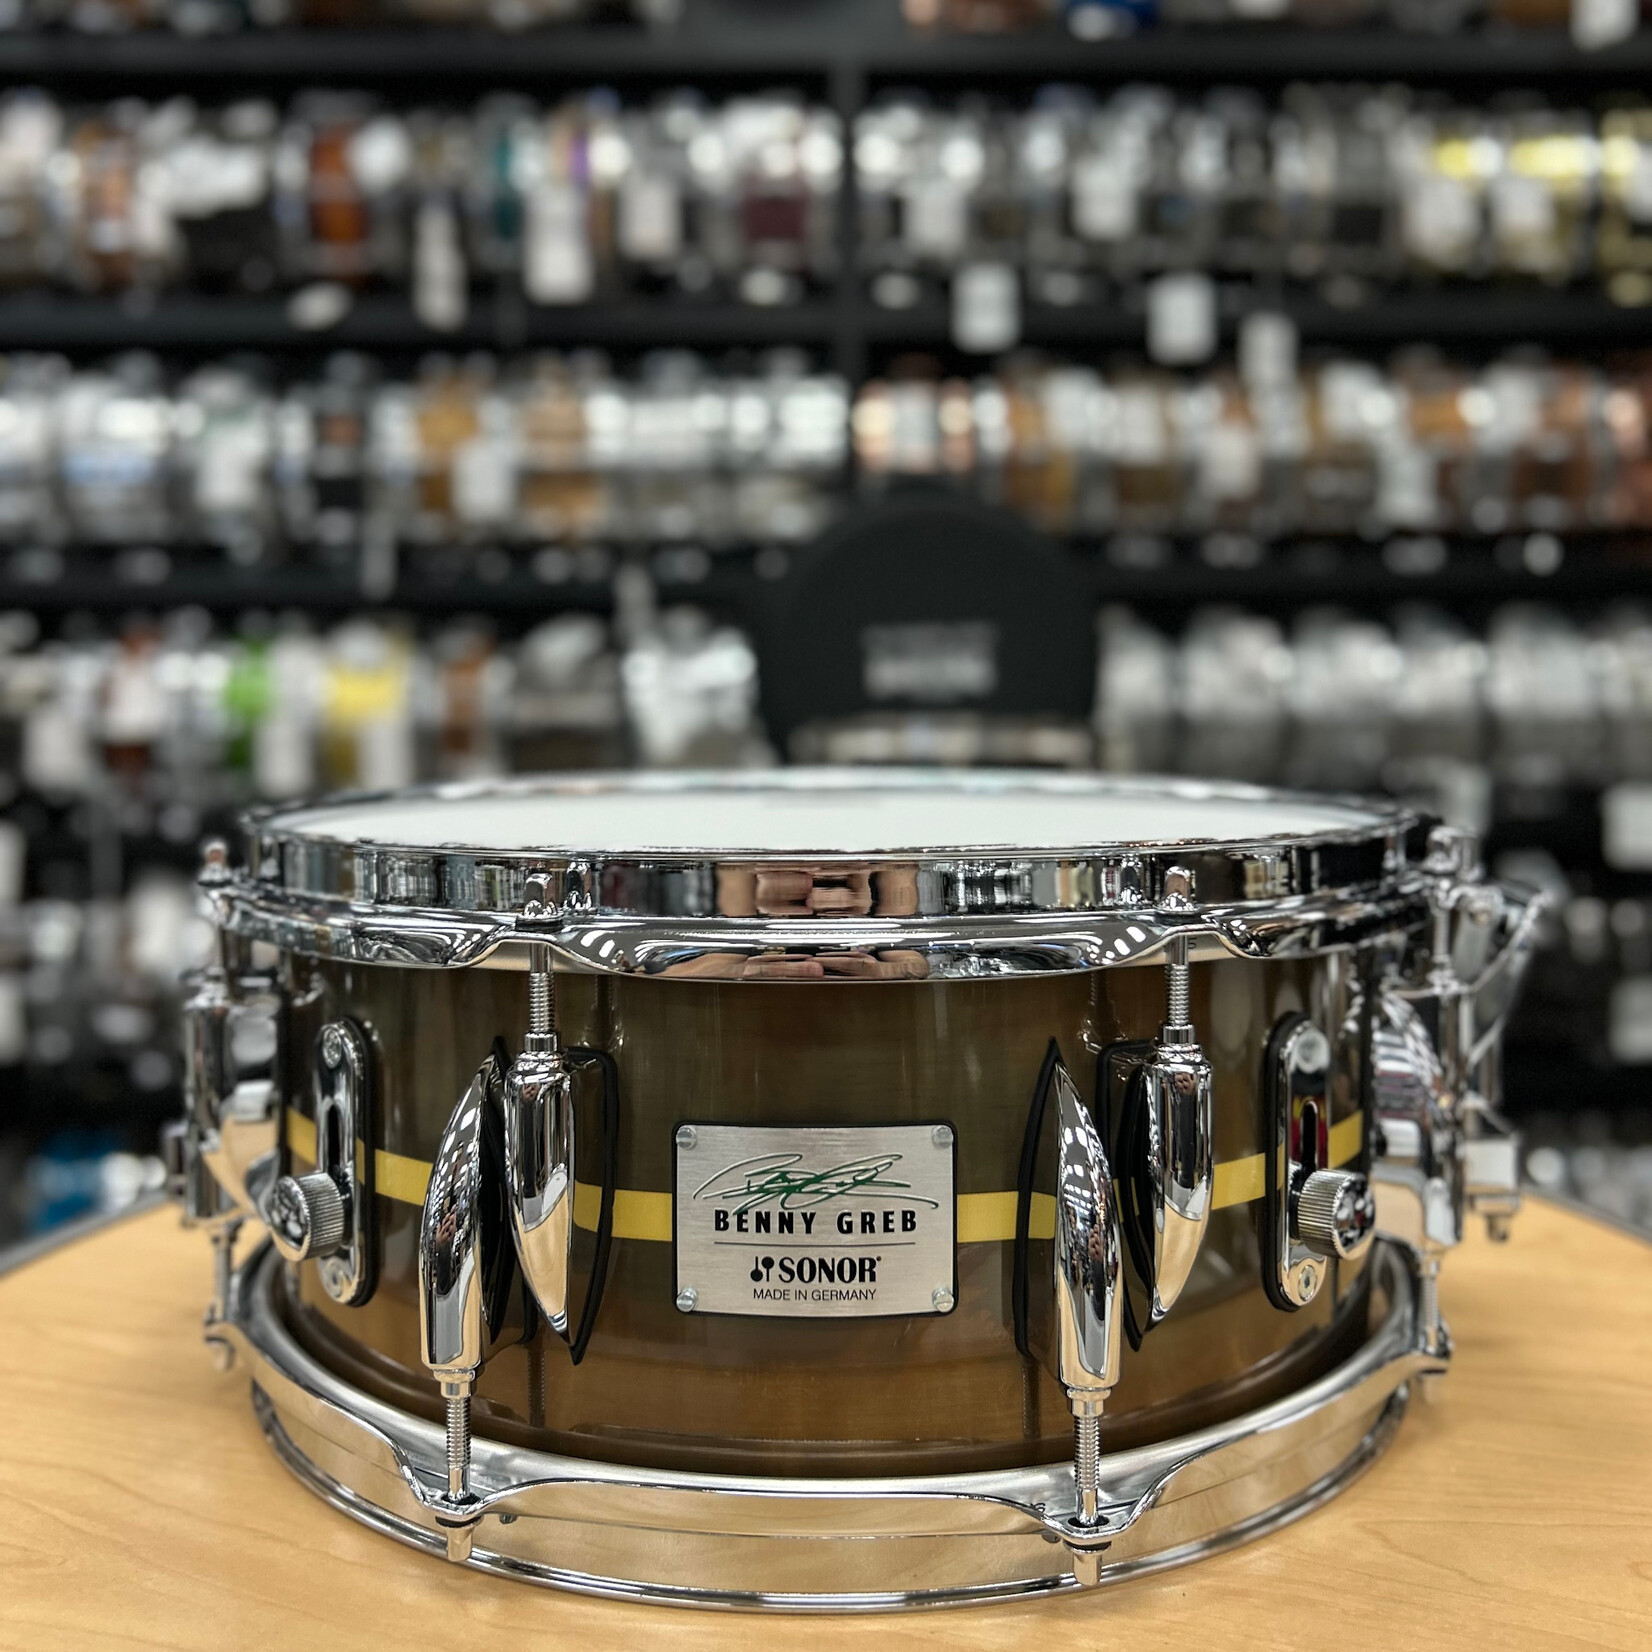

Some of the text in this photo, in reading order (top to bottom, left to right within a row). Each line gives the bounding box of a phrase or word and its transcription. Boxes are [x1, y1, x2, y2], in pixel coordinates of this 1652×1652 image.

[714, 1209, 917, 1235] BENNY GREB
[778, 1256, 877, 1284] SONOR
[753, 1288, 877, 1301] MADE IN GERMANY
